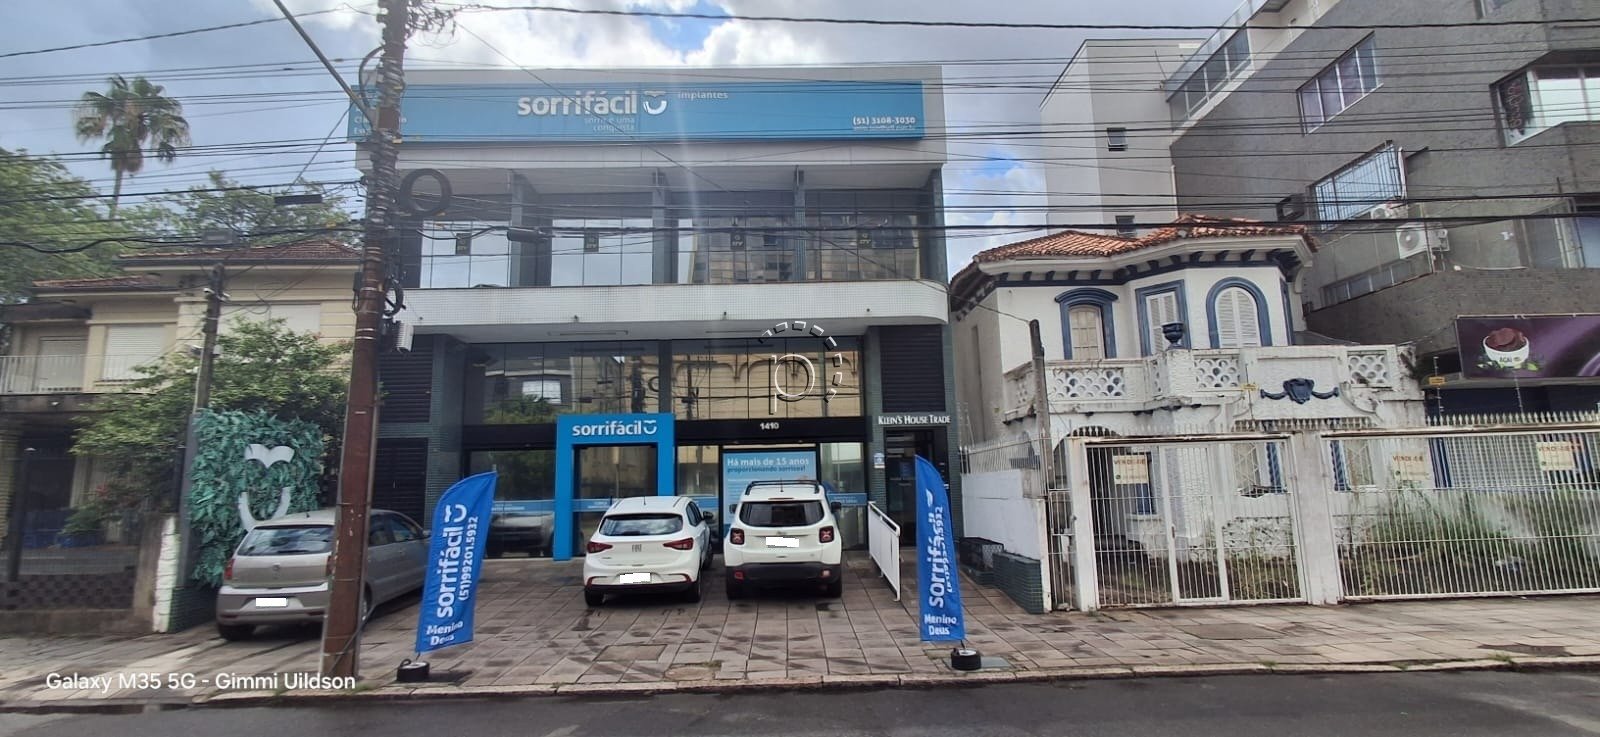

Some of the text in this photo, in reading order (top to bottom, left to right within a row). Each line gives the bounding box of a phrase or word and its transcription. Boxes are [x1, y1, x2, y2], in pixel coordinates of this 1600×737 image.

[678, 90, 728, 100] implantes
[518, 90, 637, 116] sorrifácil
[852, 116, 870, 125] (51)
[878, 414, 951, 424] KLEIN'S HOUSE TRADE
[572, 420, 642, 436] sorrifácil
[760, 422, 780, 430] 1410
[741, 458, 761, 466] mais
[458, 516, 478, 601] (51)99201.5932
[437, 526, 463, 618] sorrifácil
[924, 613, 957, 625] Menino
[426, 621, 463, 635] Menino
[928, 625, 950, 636] Deus
[430, 635, 455, 646] Deus
